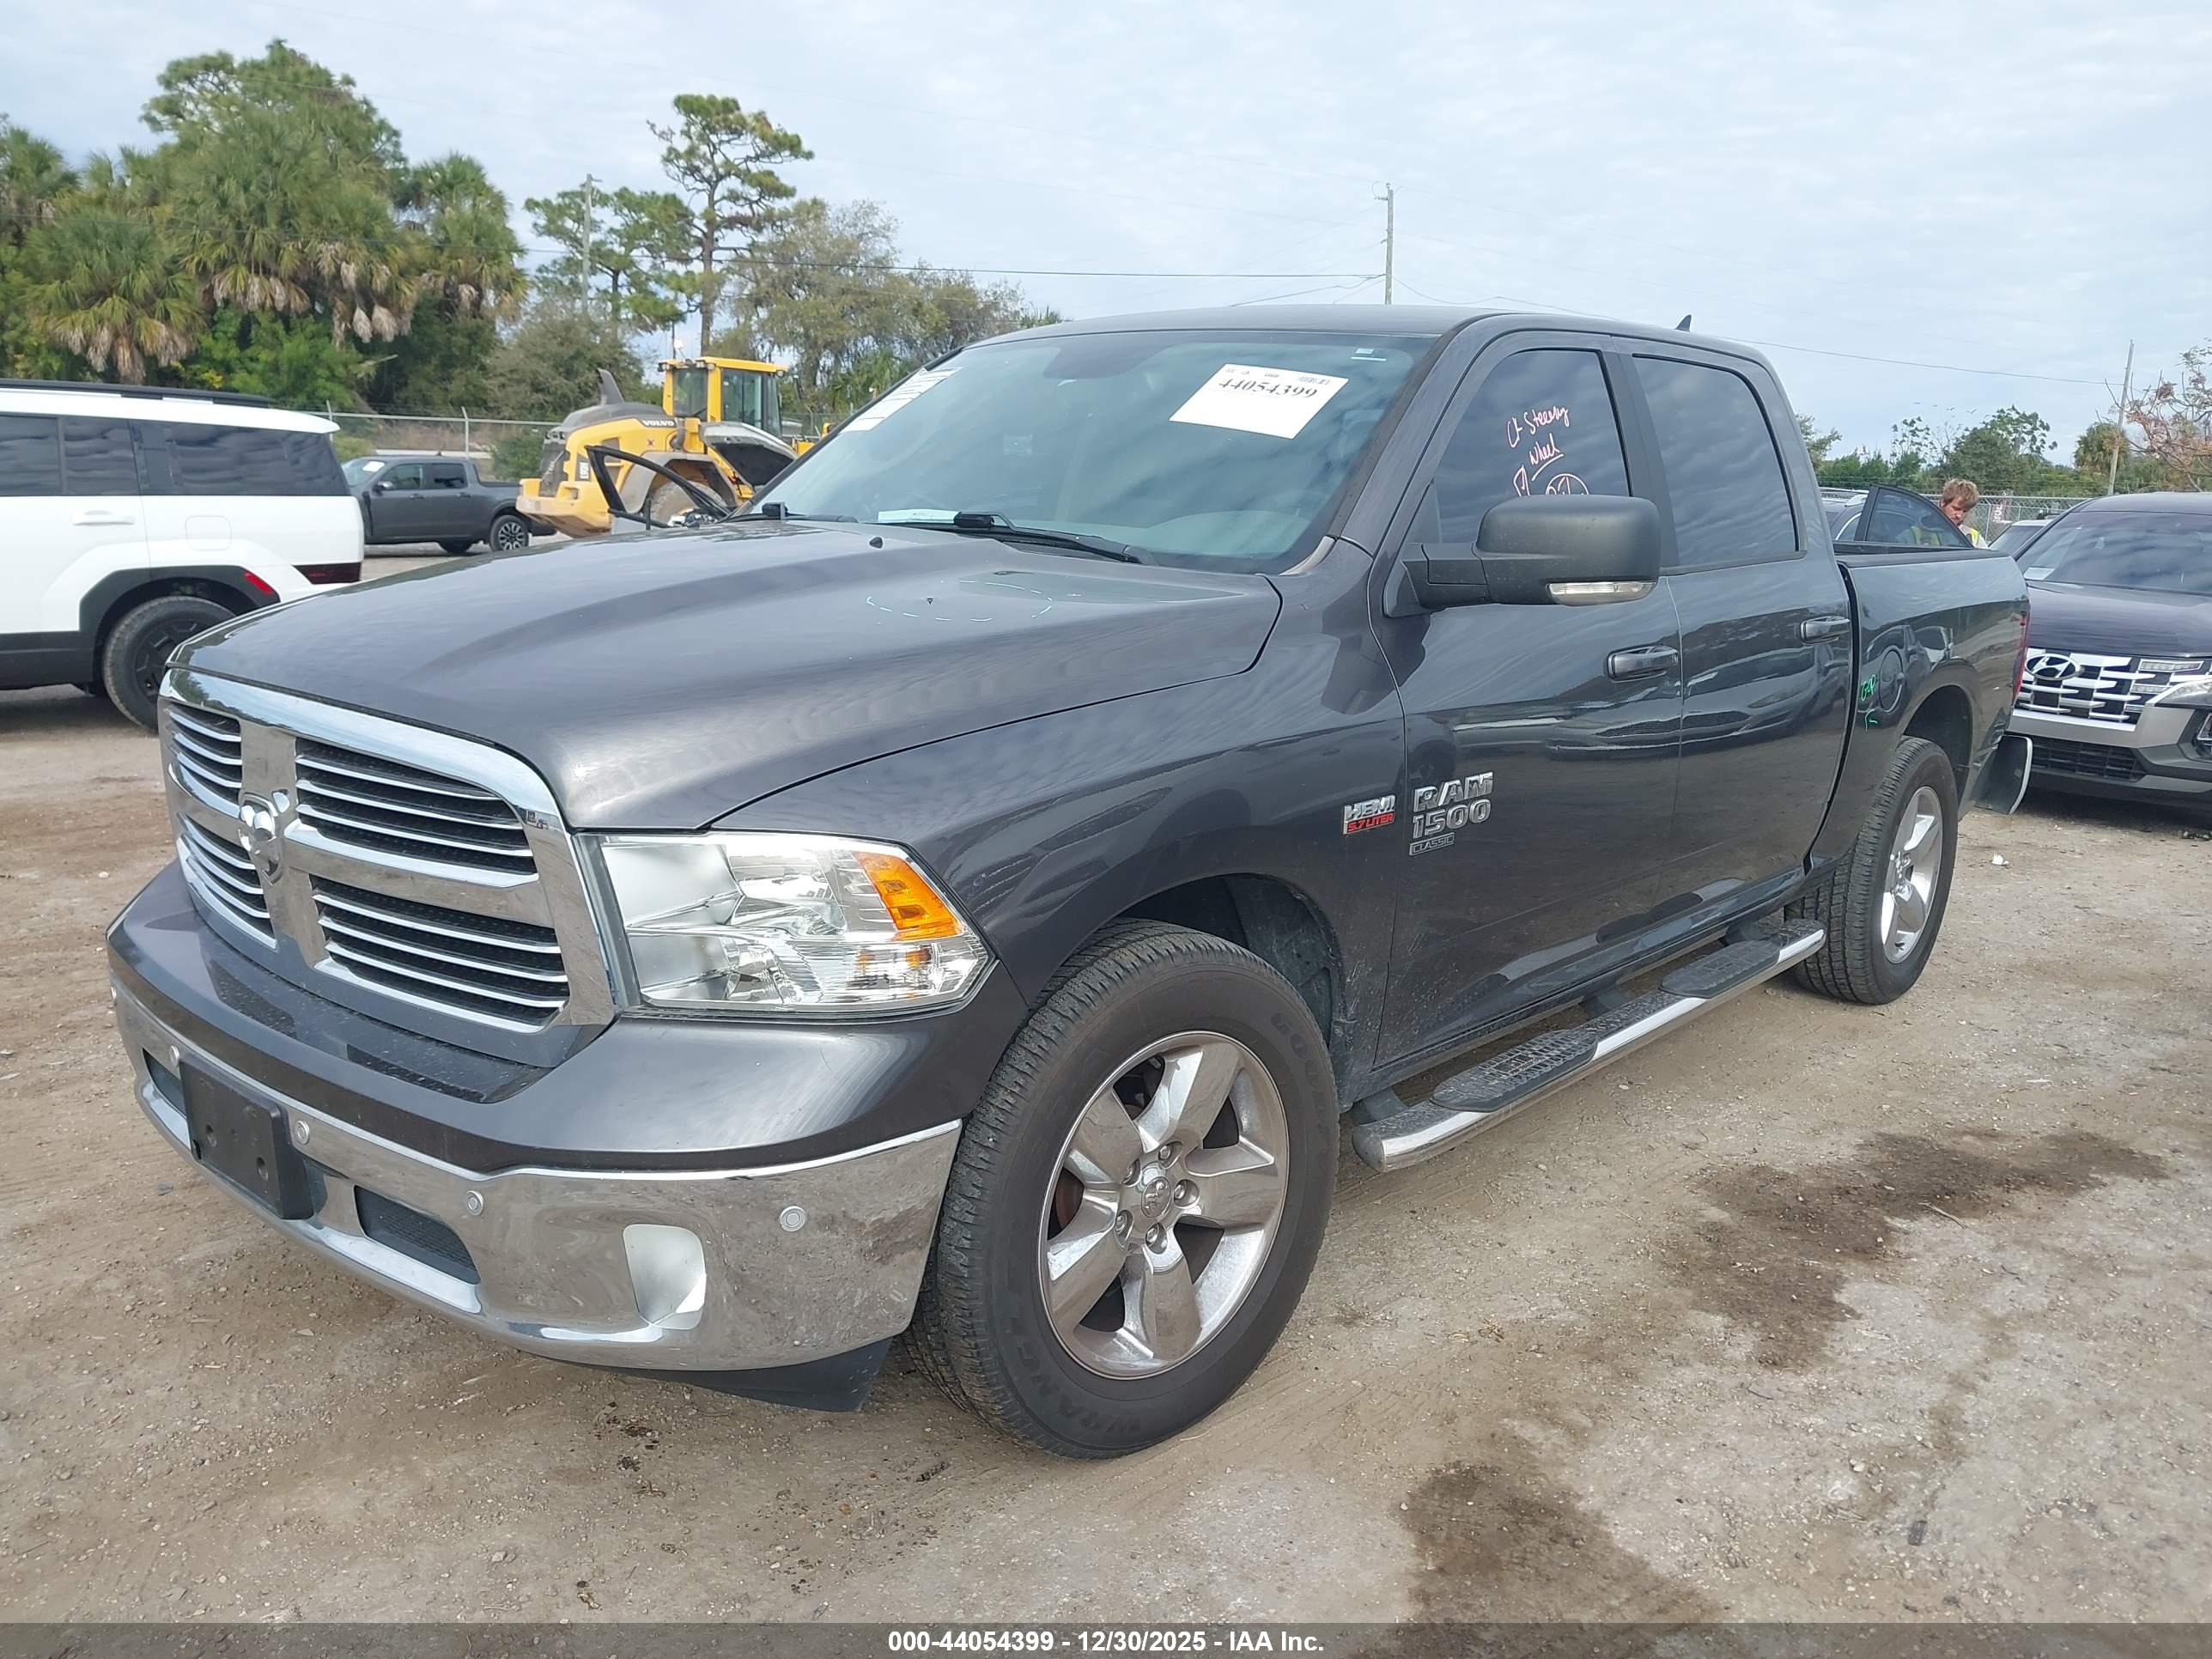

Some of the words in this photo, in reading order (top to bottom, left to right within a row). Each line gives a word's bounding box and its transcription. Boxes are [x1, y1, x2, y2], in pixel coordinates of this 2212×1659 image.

[1218, 378, 1318, 398] 44054399
[1414, 772, 1493, 811] RAM
[1343, 794, 1395, 822] HEMI
[1413, 799, 1492, 838] 1500
[1365, 812, 1394, 829] LITER
[1413, 834, 1453, 854] CLASSIC
